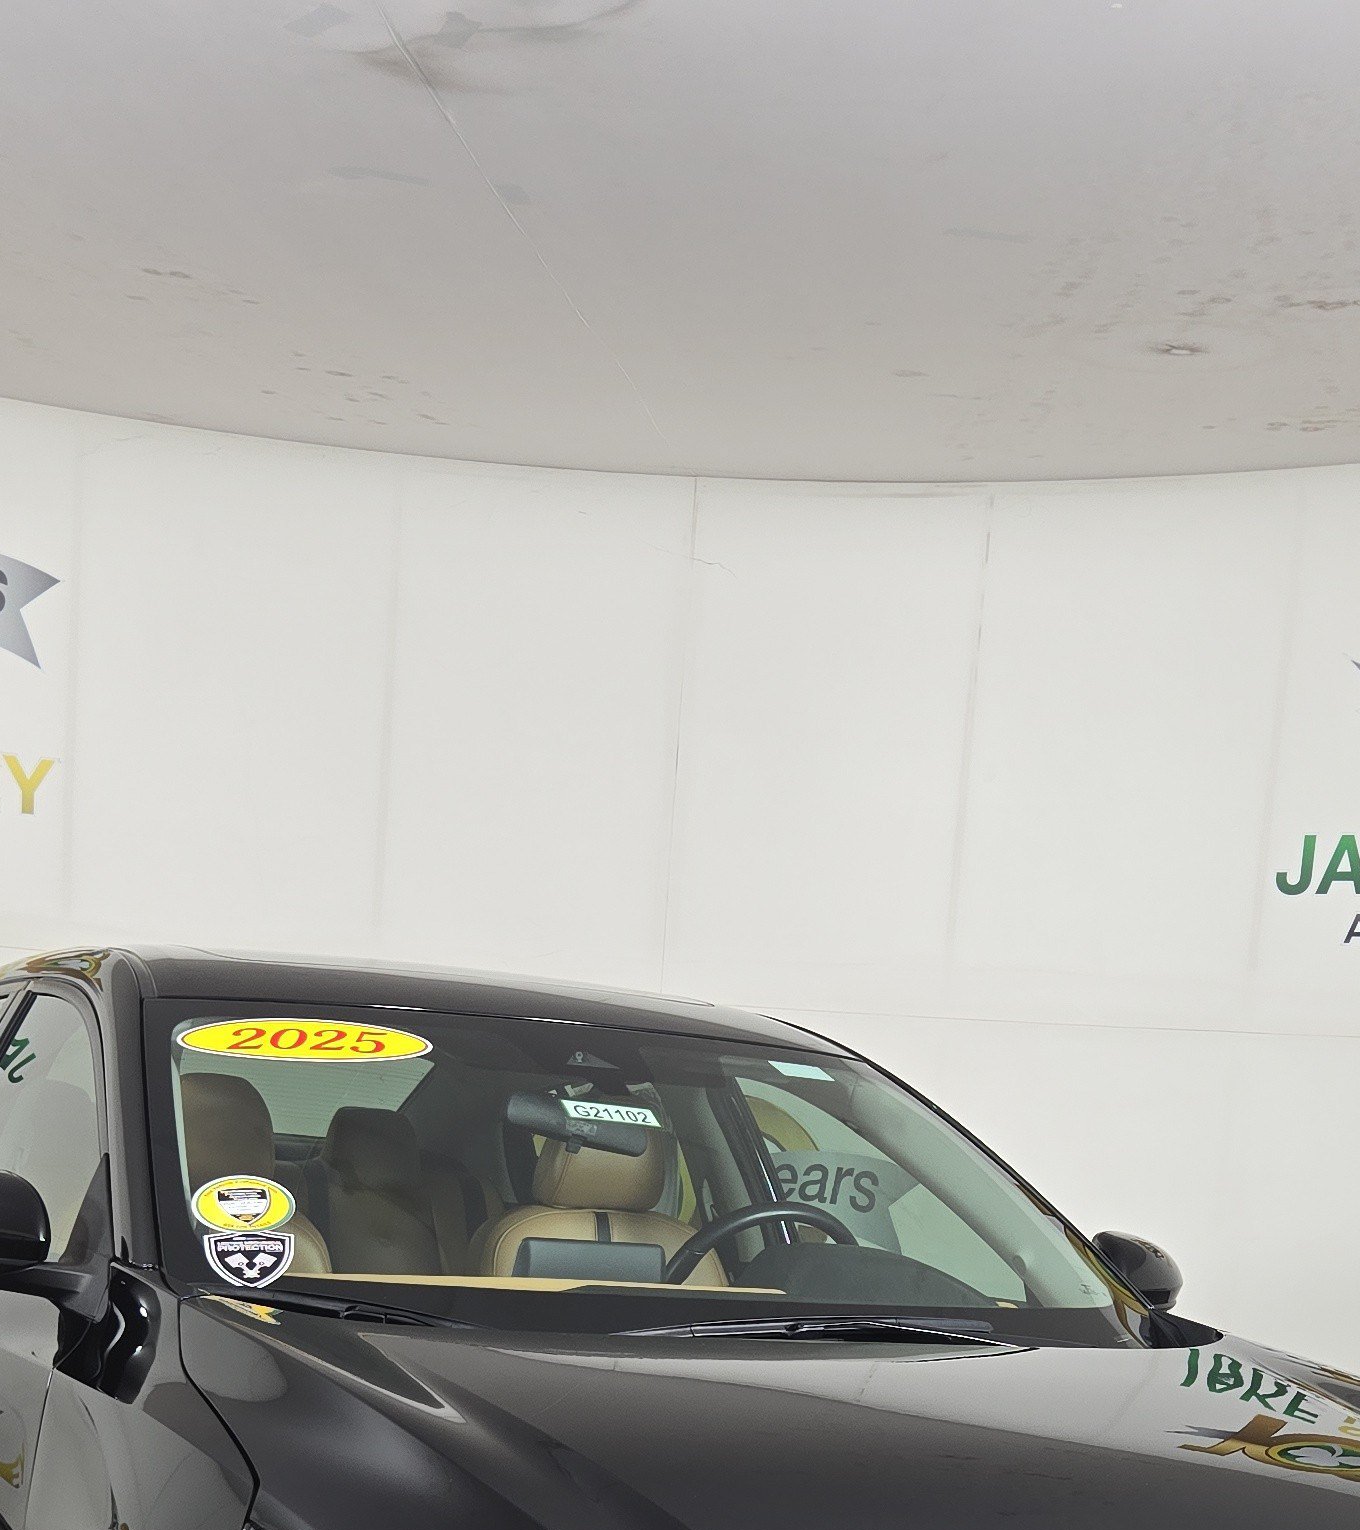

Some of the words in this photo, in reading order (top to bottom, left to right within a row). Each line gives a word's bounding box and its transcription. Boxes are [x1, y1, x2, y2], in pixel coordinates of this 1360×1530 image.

[226, 1028, 388, 1053] 2025
[573, 1105, 651, 1123] G21102
[776, 1163, 879, 1213] ears
